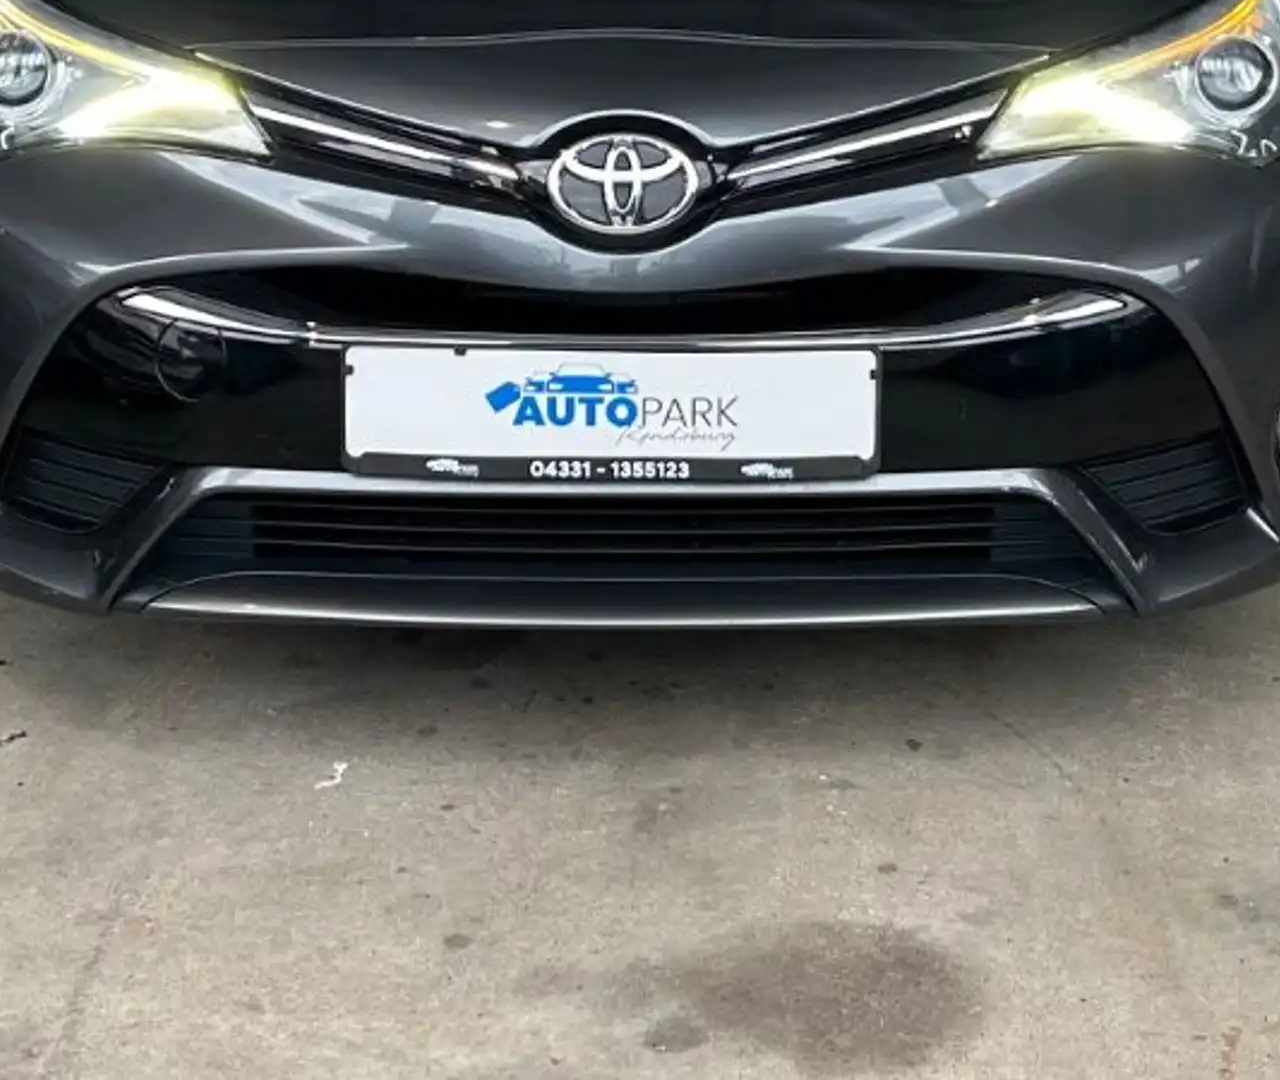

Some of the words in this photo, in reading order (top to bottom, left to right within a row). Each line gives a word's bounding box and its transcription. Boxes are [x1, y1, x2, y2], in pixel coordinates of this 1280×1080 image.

[512, 394, 739, 429] AUTOPARK
[529, 460, 591, 479] 04331
[610, 460, 690, 480] 1355123
